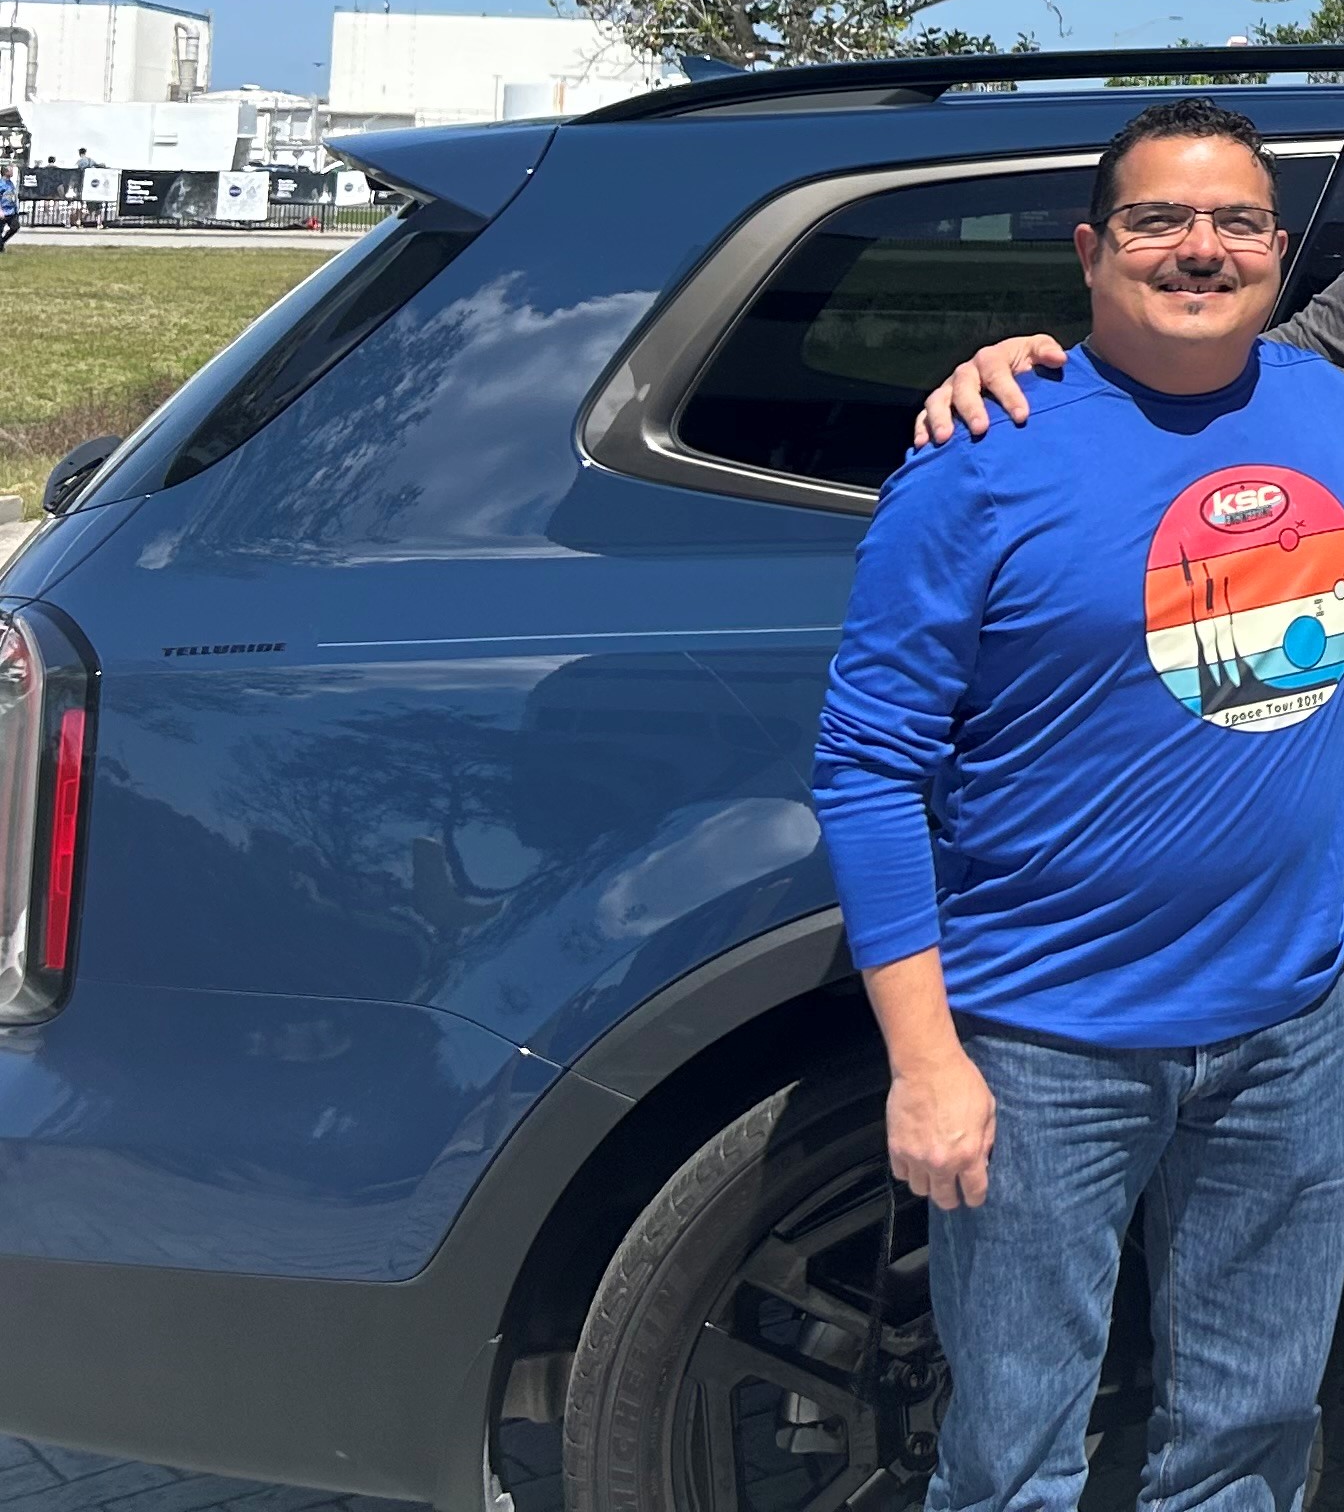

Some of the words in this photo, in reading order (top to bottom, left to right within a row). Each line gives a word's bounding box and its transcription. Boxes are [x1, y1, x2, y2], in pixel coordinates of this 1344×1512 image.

[162, 643, 287, 657] TELLURIDE
[1225, 709, 1263, 726] Space
[1266, 702, 1294, 715] Tour
